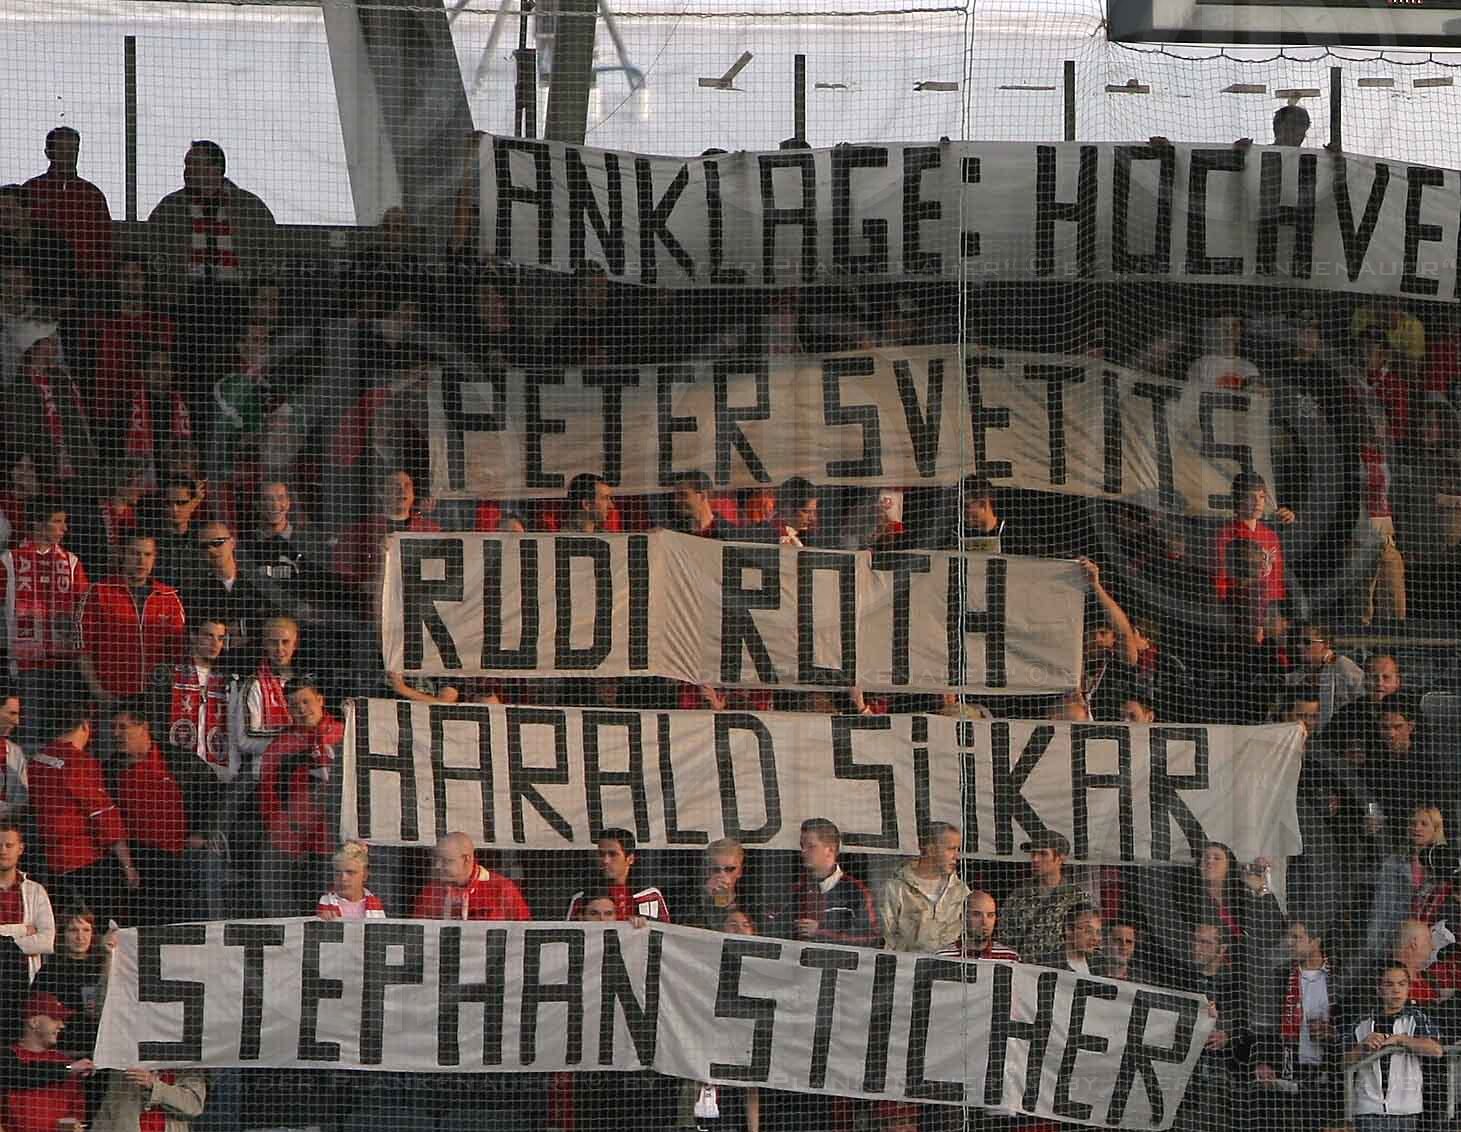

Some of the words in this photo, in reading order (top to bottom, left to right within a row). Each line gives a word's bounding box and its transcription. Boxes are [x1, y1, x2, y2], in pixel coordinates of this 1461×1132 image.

[493, 137, 982, 286] ANKLAGE:
[444, 360, 772, 492] PETER
[821, 357, 1254, 512] SVETITS
[401, 536, 652, 671] RUDI
[719, 547, 1009, 688] ROTH
[354, 701, 782, 846] HARALD
[136, 921, 664, 1067] STEPHAN
[708, 936, 1210, 1130] STICHER
